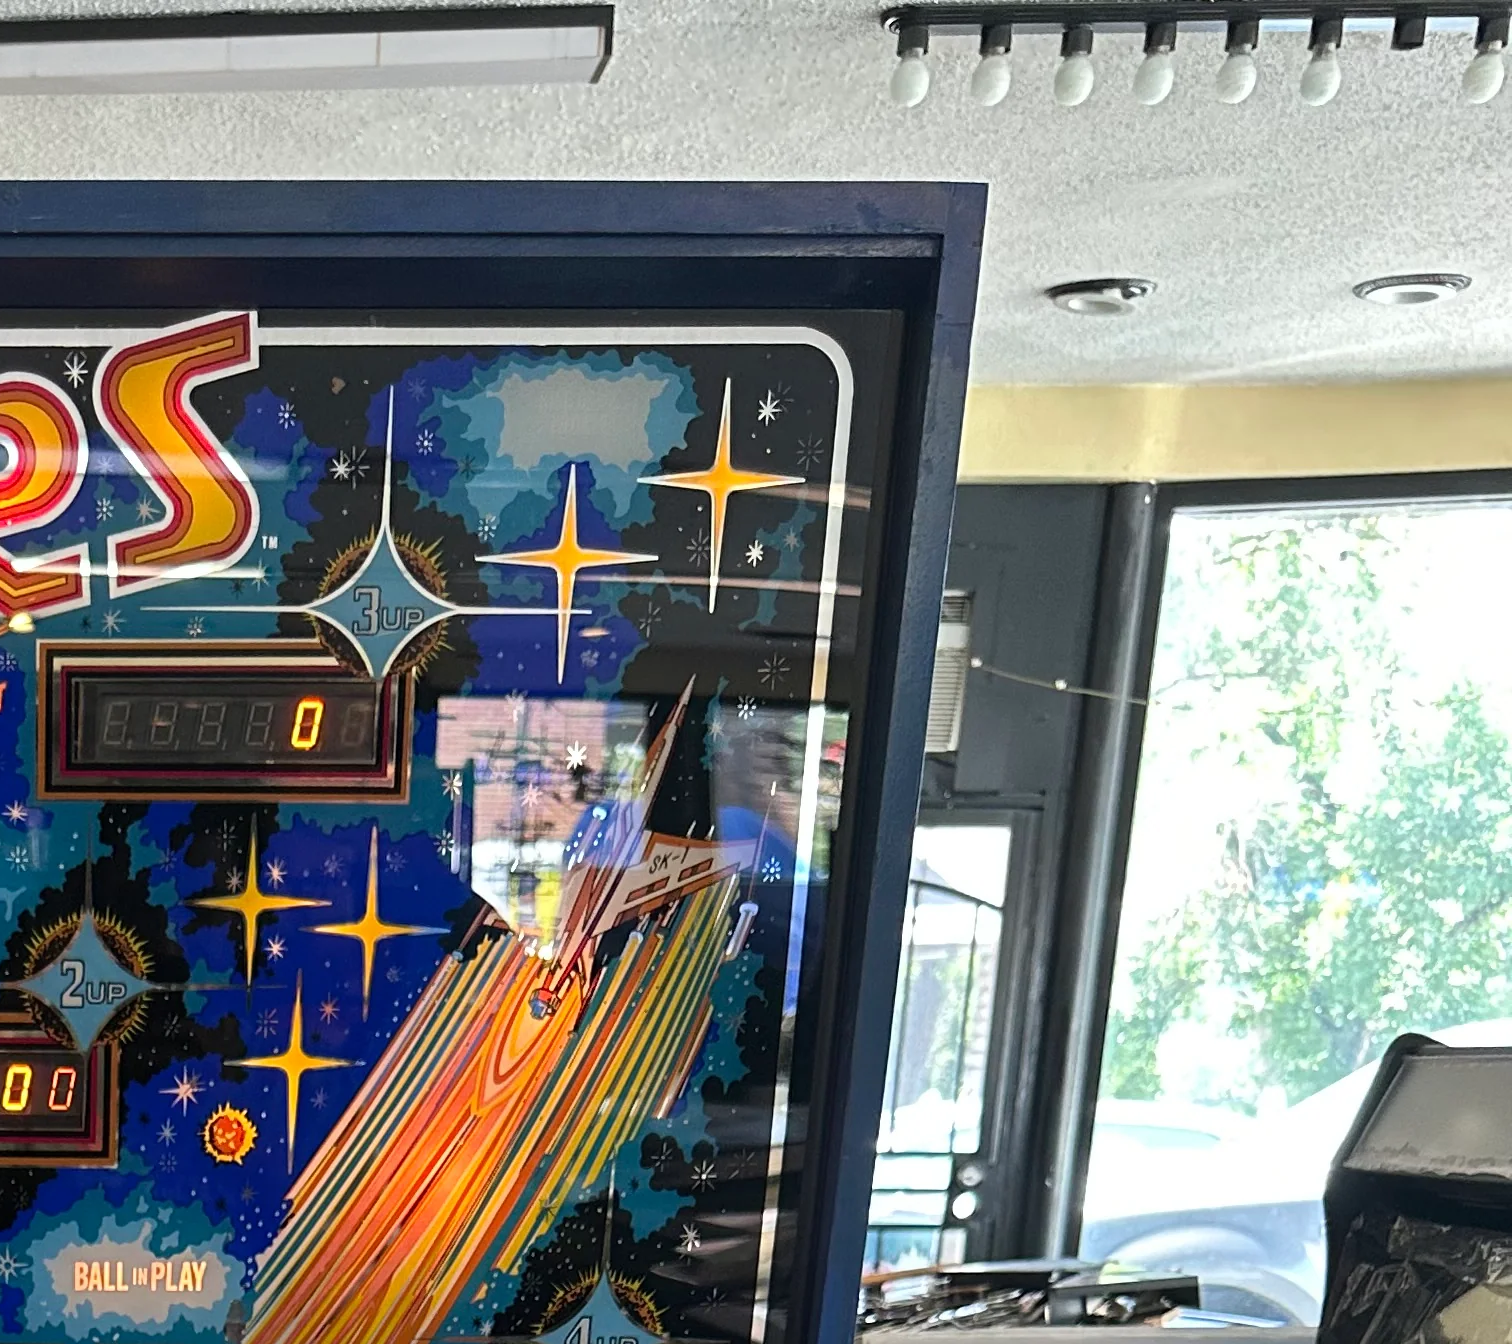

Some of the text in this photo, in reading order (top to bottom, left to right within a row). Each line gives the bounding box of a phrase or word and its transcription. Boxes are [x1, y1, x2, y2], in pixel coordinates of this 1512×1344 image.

[262, 535, 278, 549] TM
[291, 696, 324, 750] 0
[649, 847, 689, 874] SK-1
[73, 1261, 207, 1291] BALL IN PLAY
